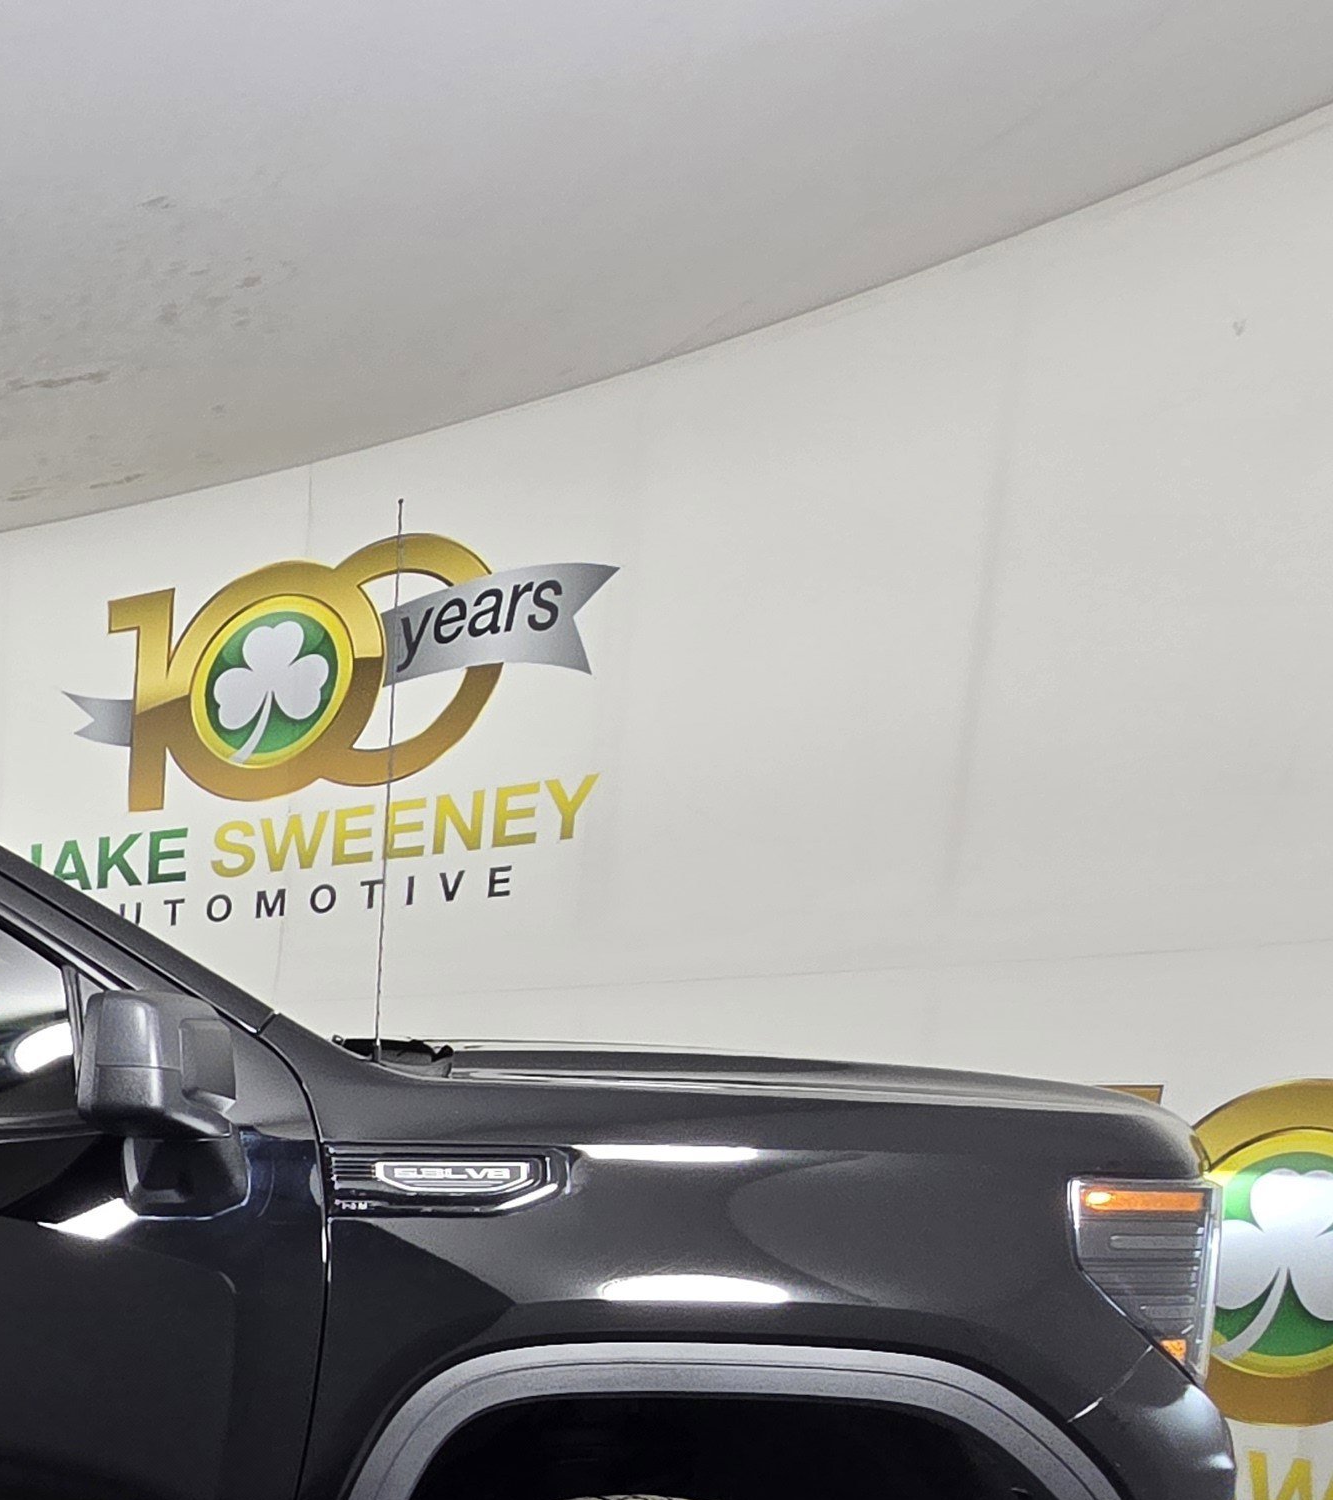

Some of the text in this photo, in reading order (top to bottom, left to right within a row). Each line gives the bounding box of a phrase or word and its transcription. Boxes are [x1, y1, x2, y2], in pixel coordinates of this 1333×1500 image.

[397, 577, 563, 671] years
[210, 773, 600, 878] SWEENEY
[118, 865, 513, 926] UTOMOTIVE
